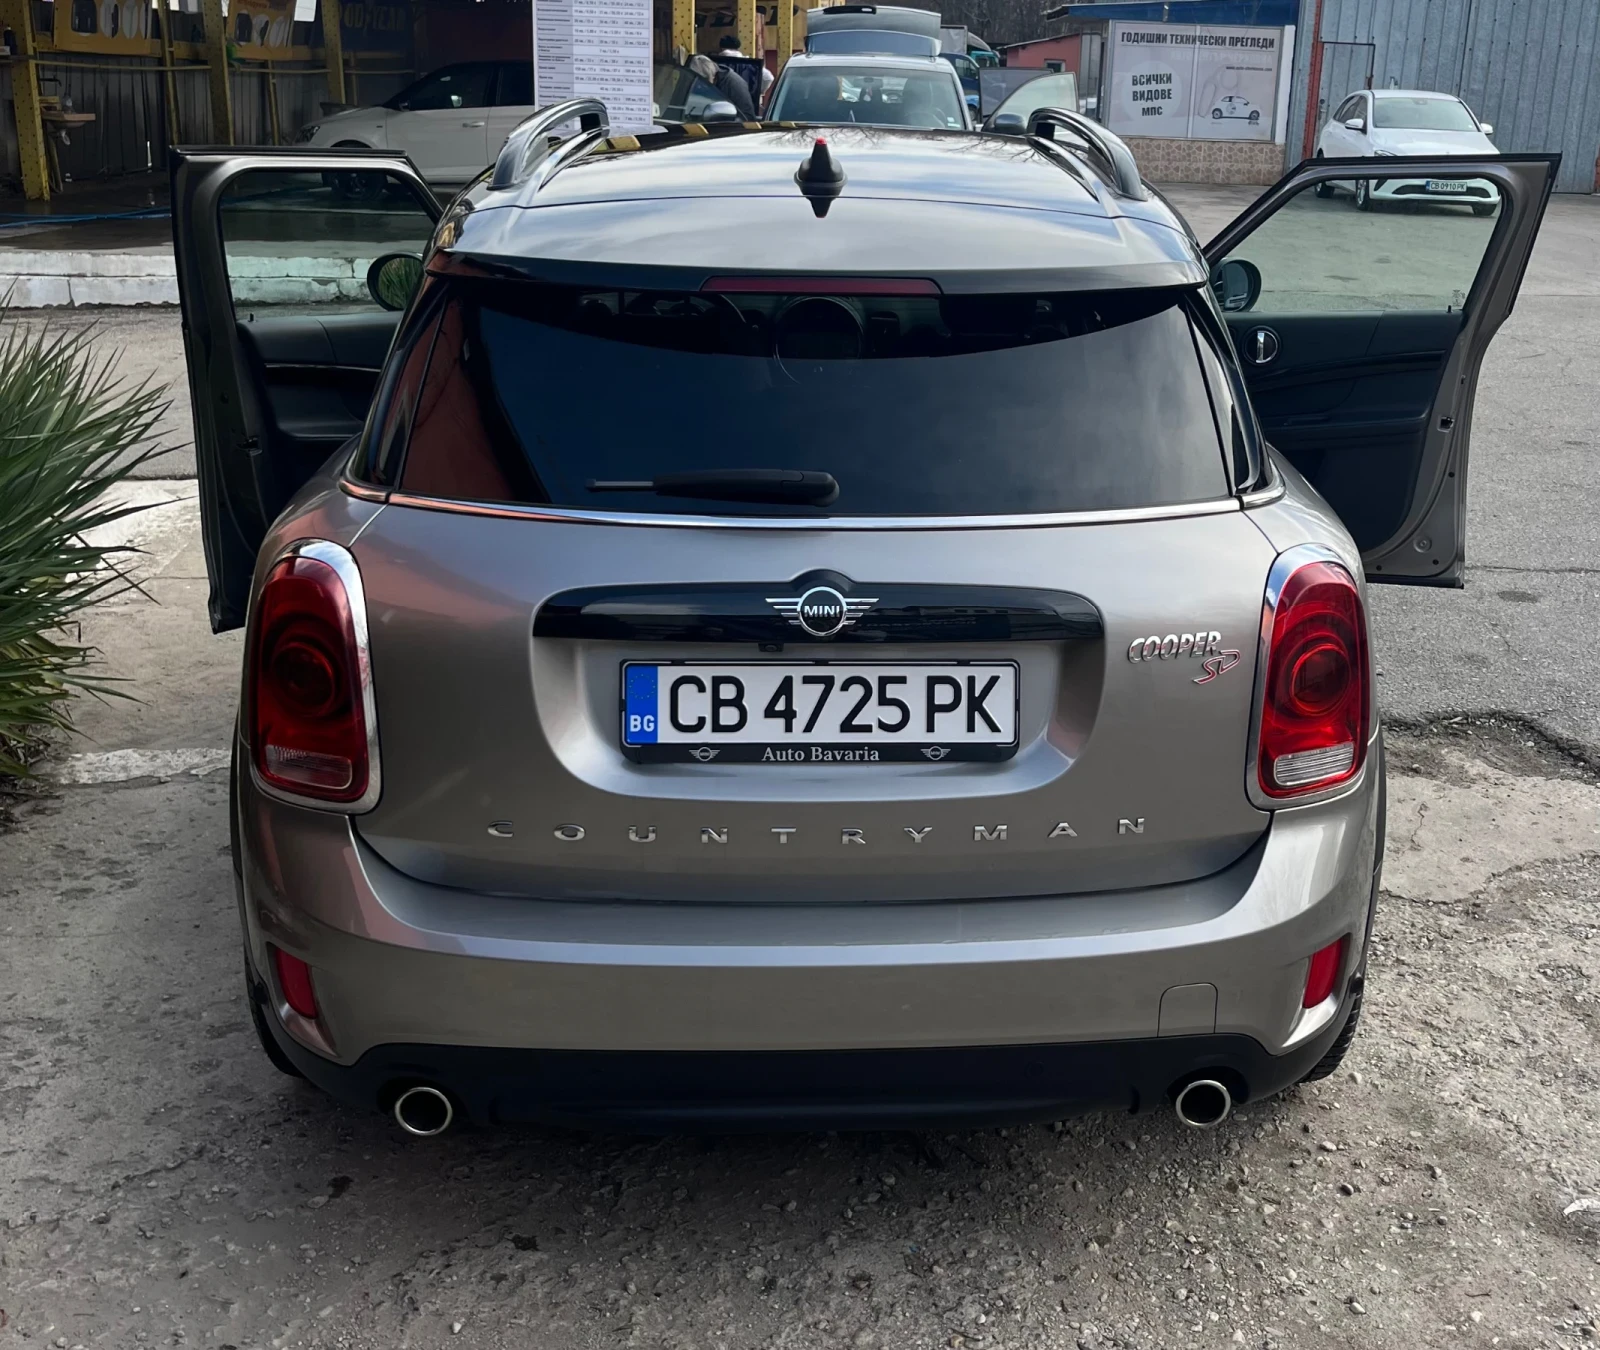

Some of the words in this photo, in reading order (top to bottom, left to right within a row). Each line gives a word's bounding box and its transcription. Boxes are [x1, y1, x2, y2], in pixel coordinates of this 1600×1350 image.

[1121, 31, 1168, 44] ГОДИШНИ
[1169, 33, 1227, 47] ТЕХНИЧЕСКИ
[1228, 36, 1275, 49] ПРЕГЛЕДИ
[1131, 72, 1172, 86] ВСИЧКИ
[1132, 88, 1172, 102] ВИДОВЕ
[1141, 106, 1163, 117] МПС
[1440, 182, 1456, 190] 0910
[803, 605, 841, 617] MINI
[1127, 630, 1222, 664] COOPER
[1192, 649, 1241, 685] SD
[669, 674, 748, 734] CB
[764, 674, 911, 734] 4725
[925, 674, 1003, 734] PK
[629, 715, 655, 732] BG
[761, 746, 805, 762] Auto
[810, 746, 880, 762] Bavaria
[486, 817, 1146, 845] COUNTRYMAN
